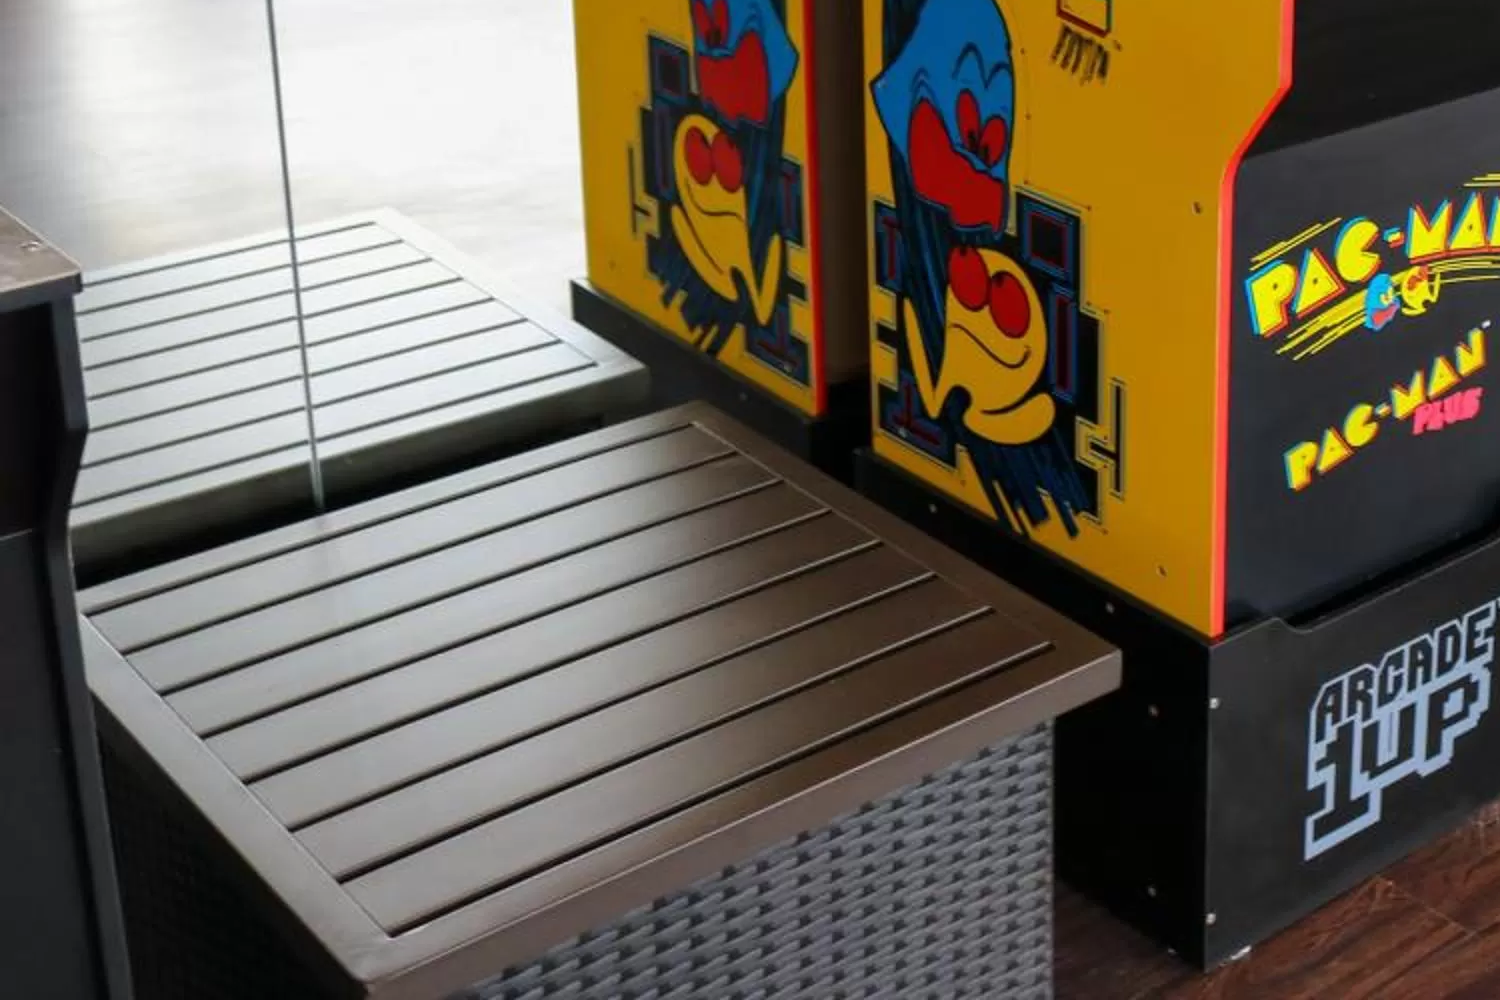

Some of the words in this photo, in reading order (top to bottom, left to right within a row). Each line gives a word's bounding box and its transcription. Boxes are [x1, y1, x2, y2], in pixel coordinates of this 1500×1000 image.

[1284, 327, 1487, 491] PAC-MAN
[1413, 387, 1484, 435] PLUS
[1308, 600, 1498, 746] ARCADE
[1304, 666, 1491, 861] 1UP
